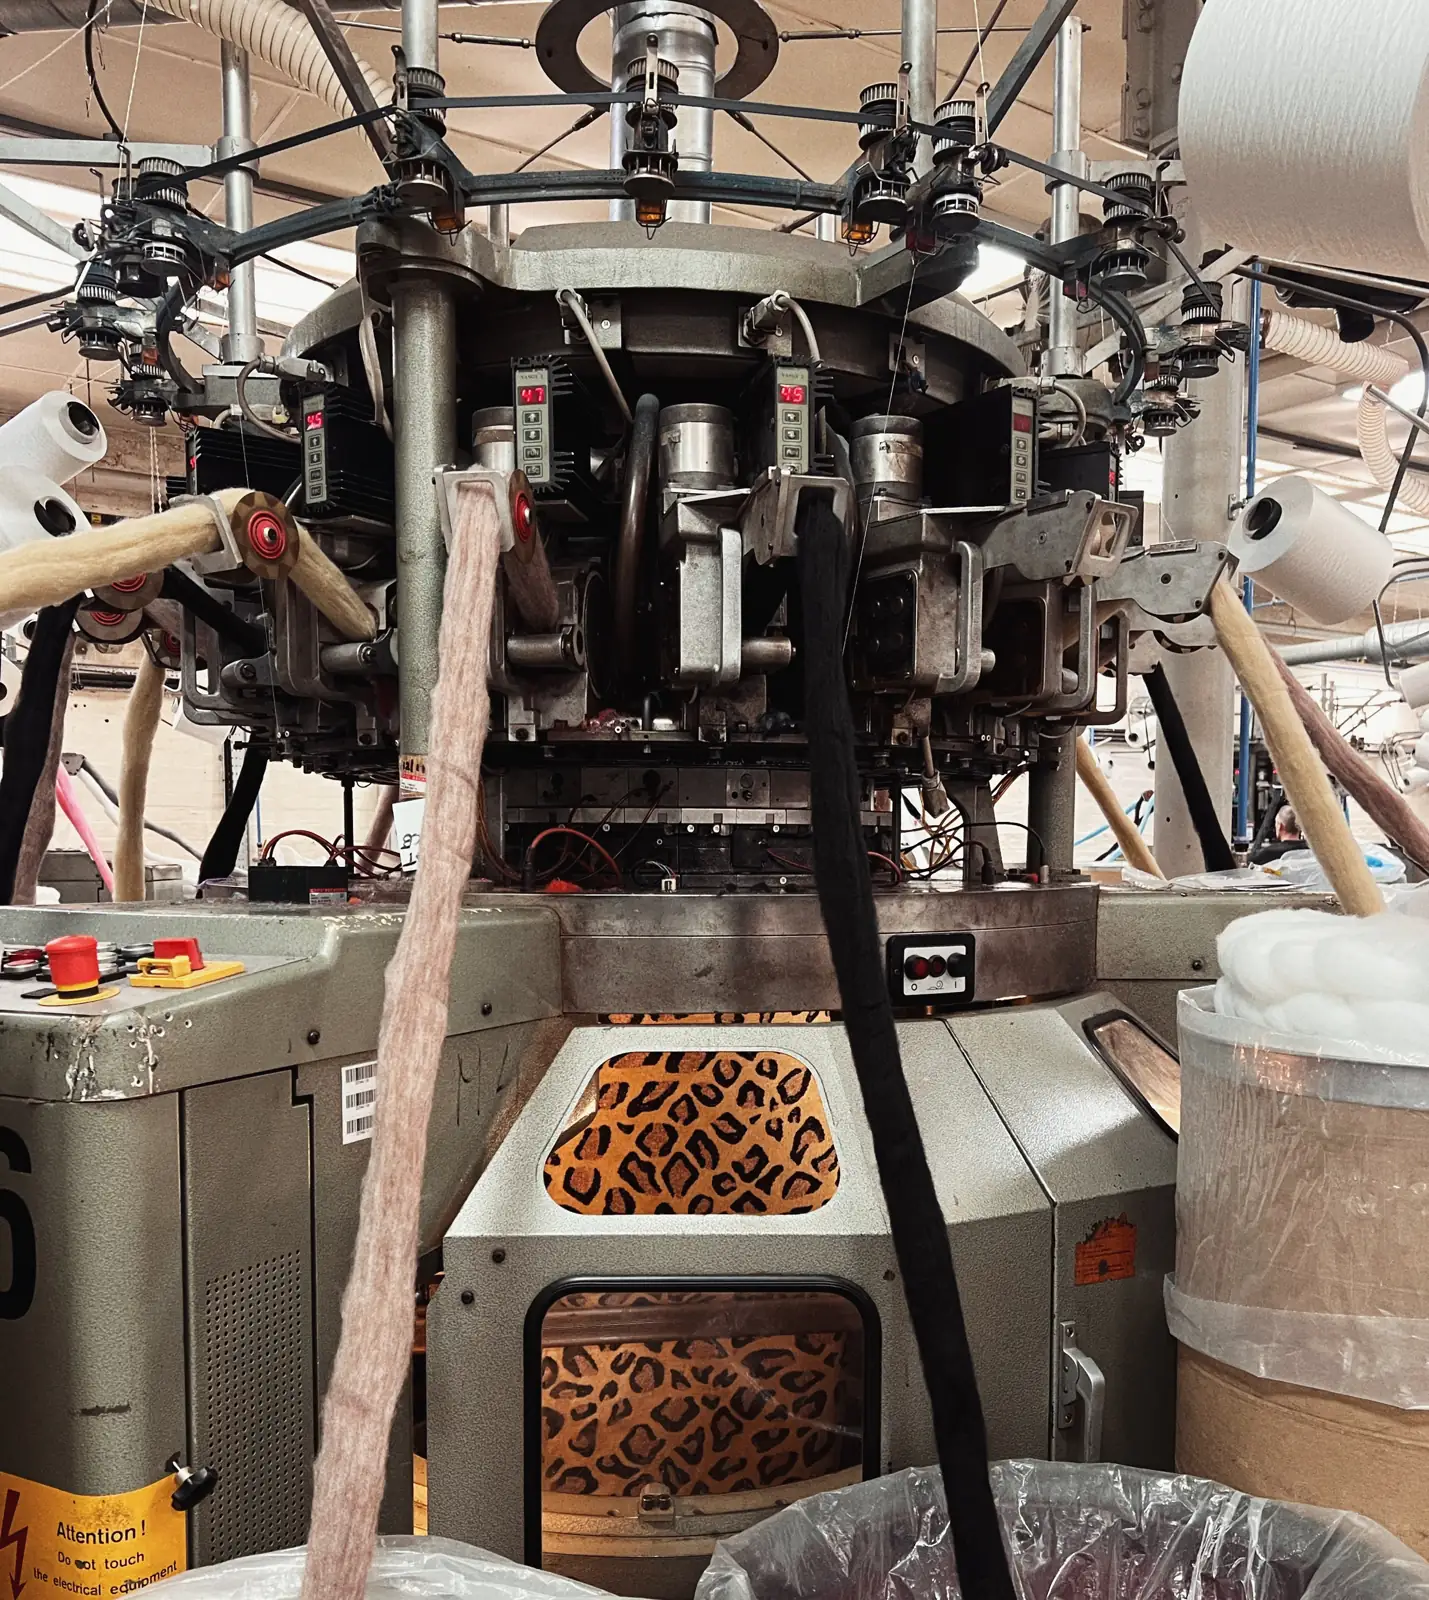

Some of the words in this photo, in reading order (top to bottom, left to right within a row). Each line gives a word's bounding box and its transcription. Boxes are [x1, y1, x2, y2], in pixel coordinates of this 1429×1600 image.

[521, 387, 545, 402] 47
[781, 386, 803, 403] 45
[56, 1521, 137, 1545] Attention
[58, 1551, 71, 1565] Do
[75, 1558, 96, 1570] ot
[104, 1552, 145, 1570] touch
[33, 1567, 49, 1582] the
[53, 1577, 101, 1596] electrical
[110, 1560, 178, 1595] equipment
